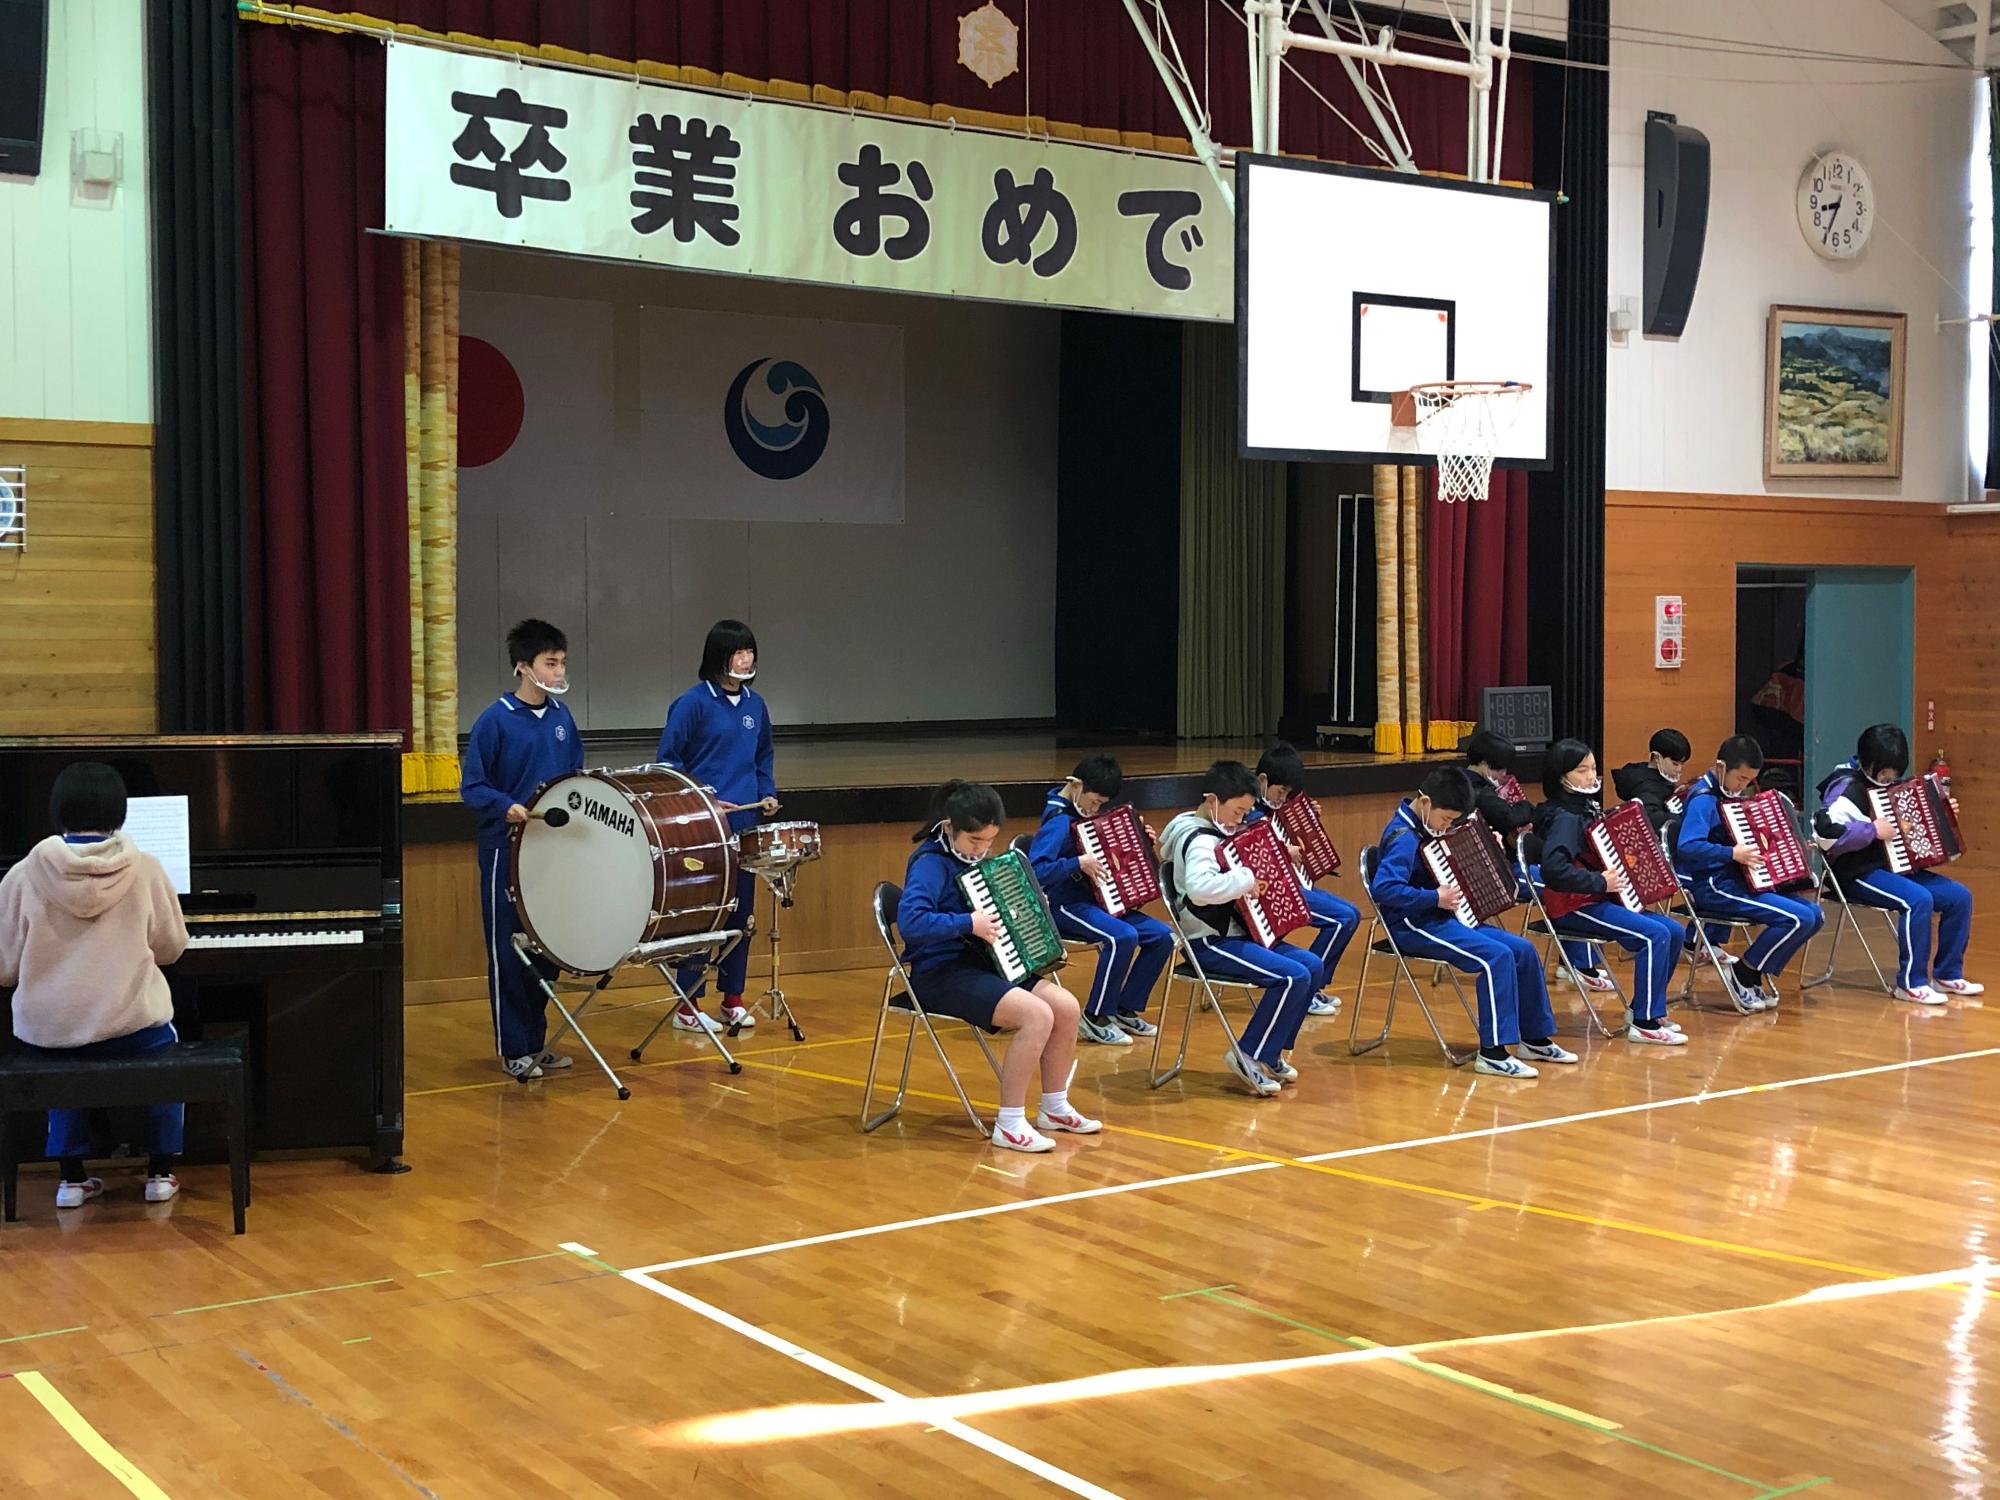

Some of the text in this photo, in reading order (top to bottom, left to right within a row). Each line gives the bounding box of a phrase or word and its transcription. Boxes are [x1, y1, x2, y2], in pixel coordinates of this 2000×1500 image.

[1832, 164, 1843, 179] 12
[1847, 170, 1851, 184] 1
[1813, 178, 1823, 192] 10
[1810, 195, 1818, 209] 9
[1856, 201, 1863, 215] 3
[1814, 211, 1821, 226] 8
[1851, 218, 1859, 231] 4
[1831, 232, 1839, 247] 6
[1843, 229, 1851, 244] 5
[584, 797, 635, 837] YAMAHA
